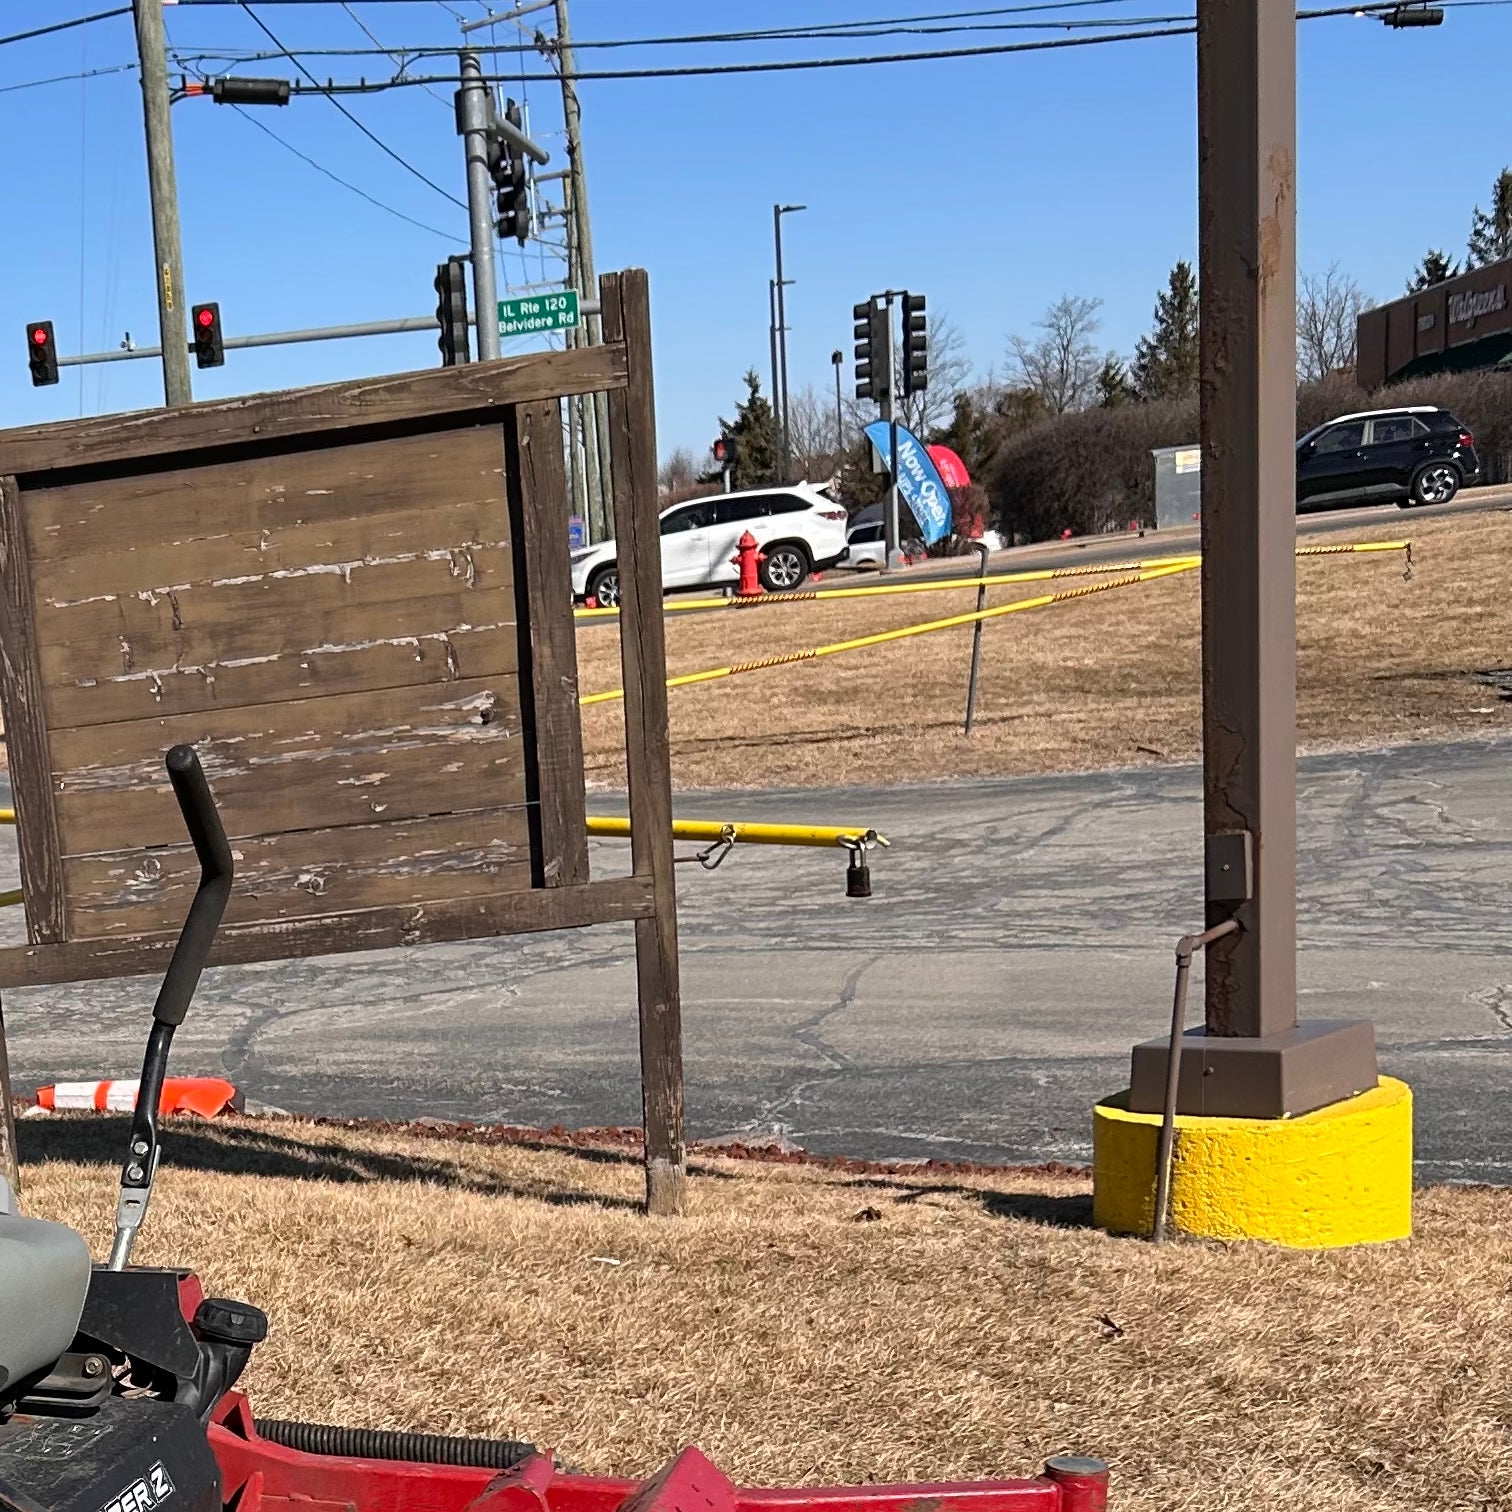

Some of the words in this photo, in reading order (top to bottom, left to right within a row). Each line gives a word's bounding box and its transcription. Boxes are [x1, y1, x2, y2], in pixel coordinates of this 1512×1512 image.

[502, 304, 515, 317] IL
[520, 301, 540, 315] Rte
[544, 296, 567, 311] 120
[498, 316, 554, 333] Belvidere
[558, 311, 574, 325] Rd
[897, 440, 927, 482] Now
[150, 1466, 170, 1499] Z
